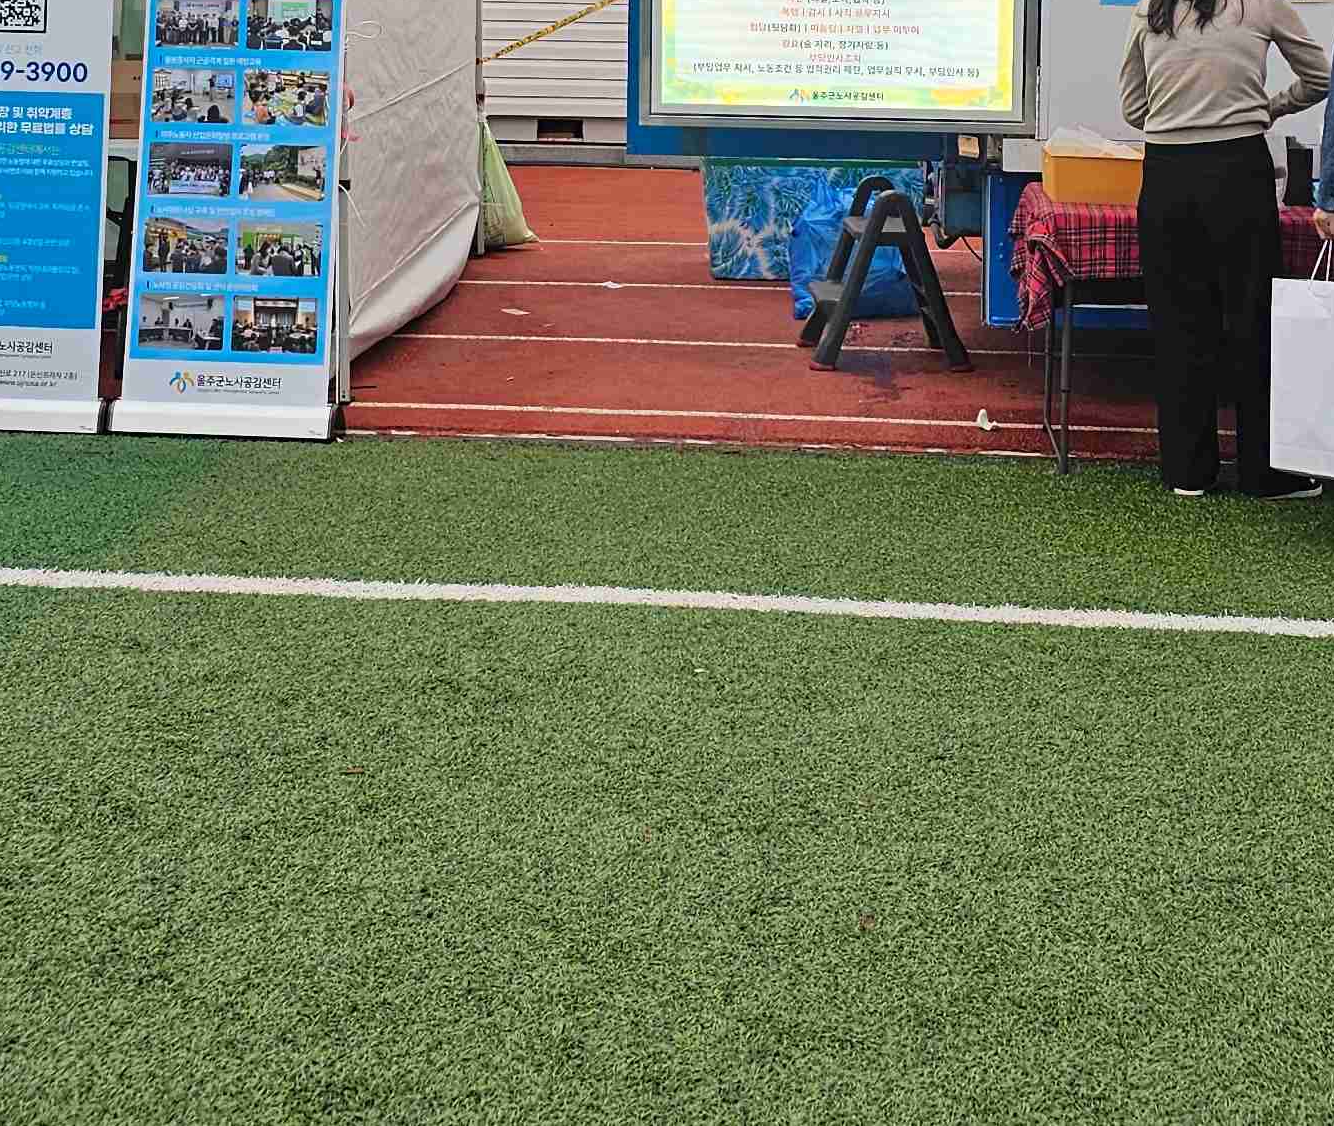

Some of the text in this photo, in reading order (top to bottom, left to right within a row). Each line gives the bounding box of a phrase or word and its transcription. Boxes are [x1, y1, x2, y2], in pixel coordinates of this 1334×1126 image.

[12, 106, 24, 119] 및
[26, 107, 73, 121] 취약계층
[20, 122, 66, 135] 무료법률
[69, 123, 94, 136] 상담
[197, 374, 282, 389] 울주군노사공감센터
